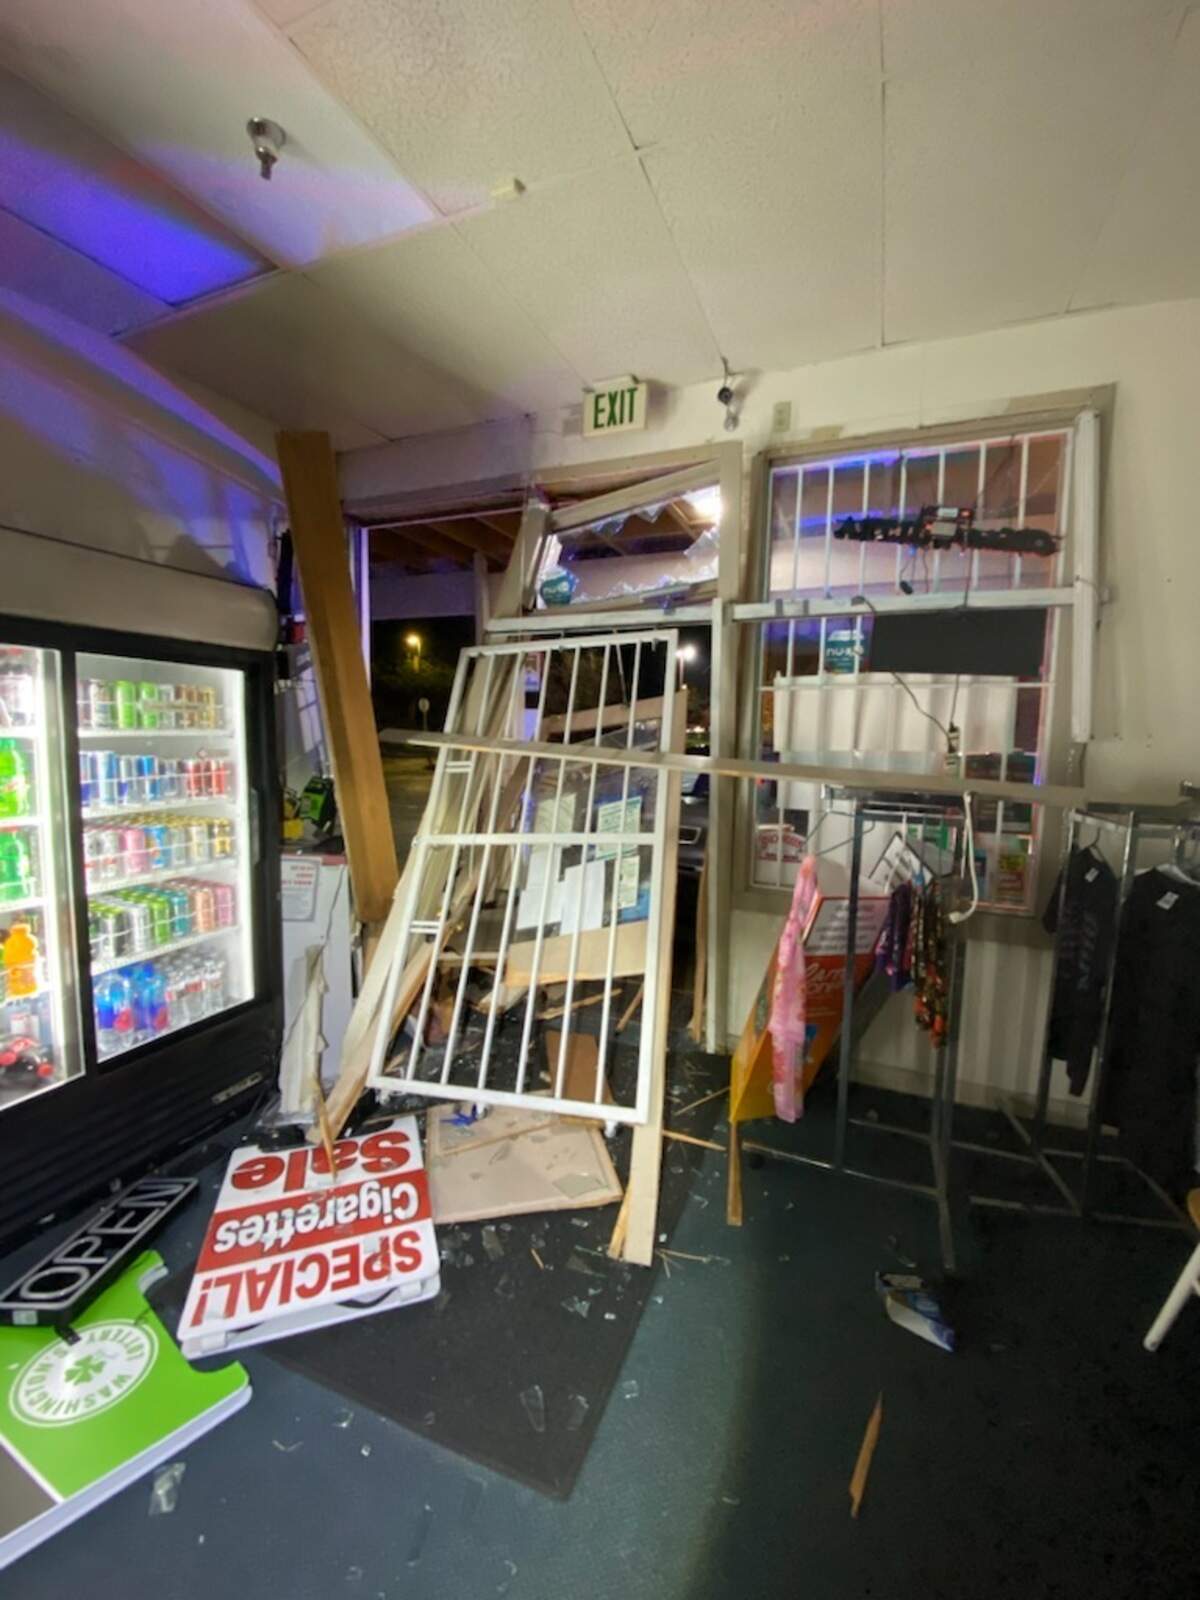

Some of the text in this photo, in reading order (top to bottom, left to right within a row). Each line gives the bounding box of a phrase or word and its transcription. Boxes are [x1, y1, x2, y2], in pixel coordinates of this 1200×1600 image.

[594, 387, 638, 429] EXIT
[231, 1131, 411, 1192] Sale
[19, 1178, 187, 1300] OPEN
[213, 1181, 419, 1253] Cigarettes
[190, 1230, 424, 1327] SPECIAL!
